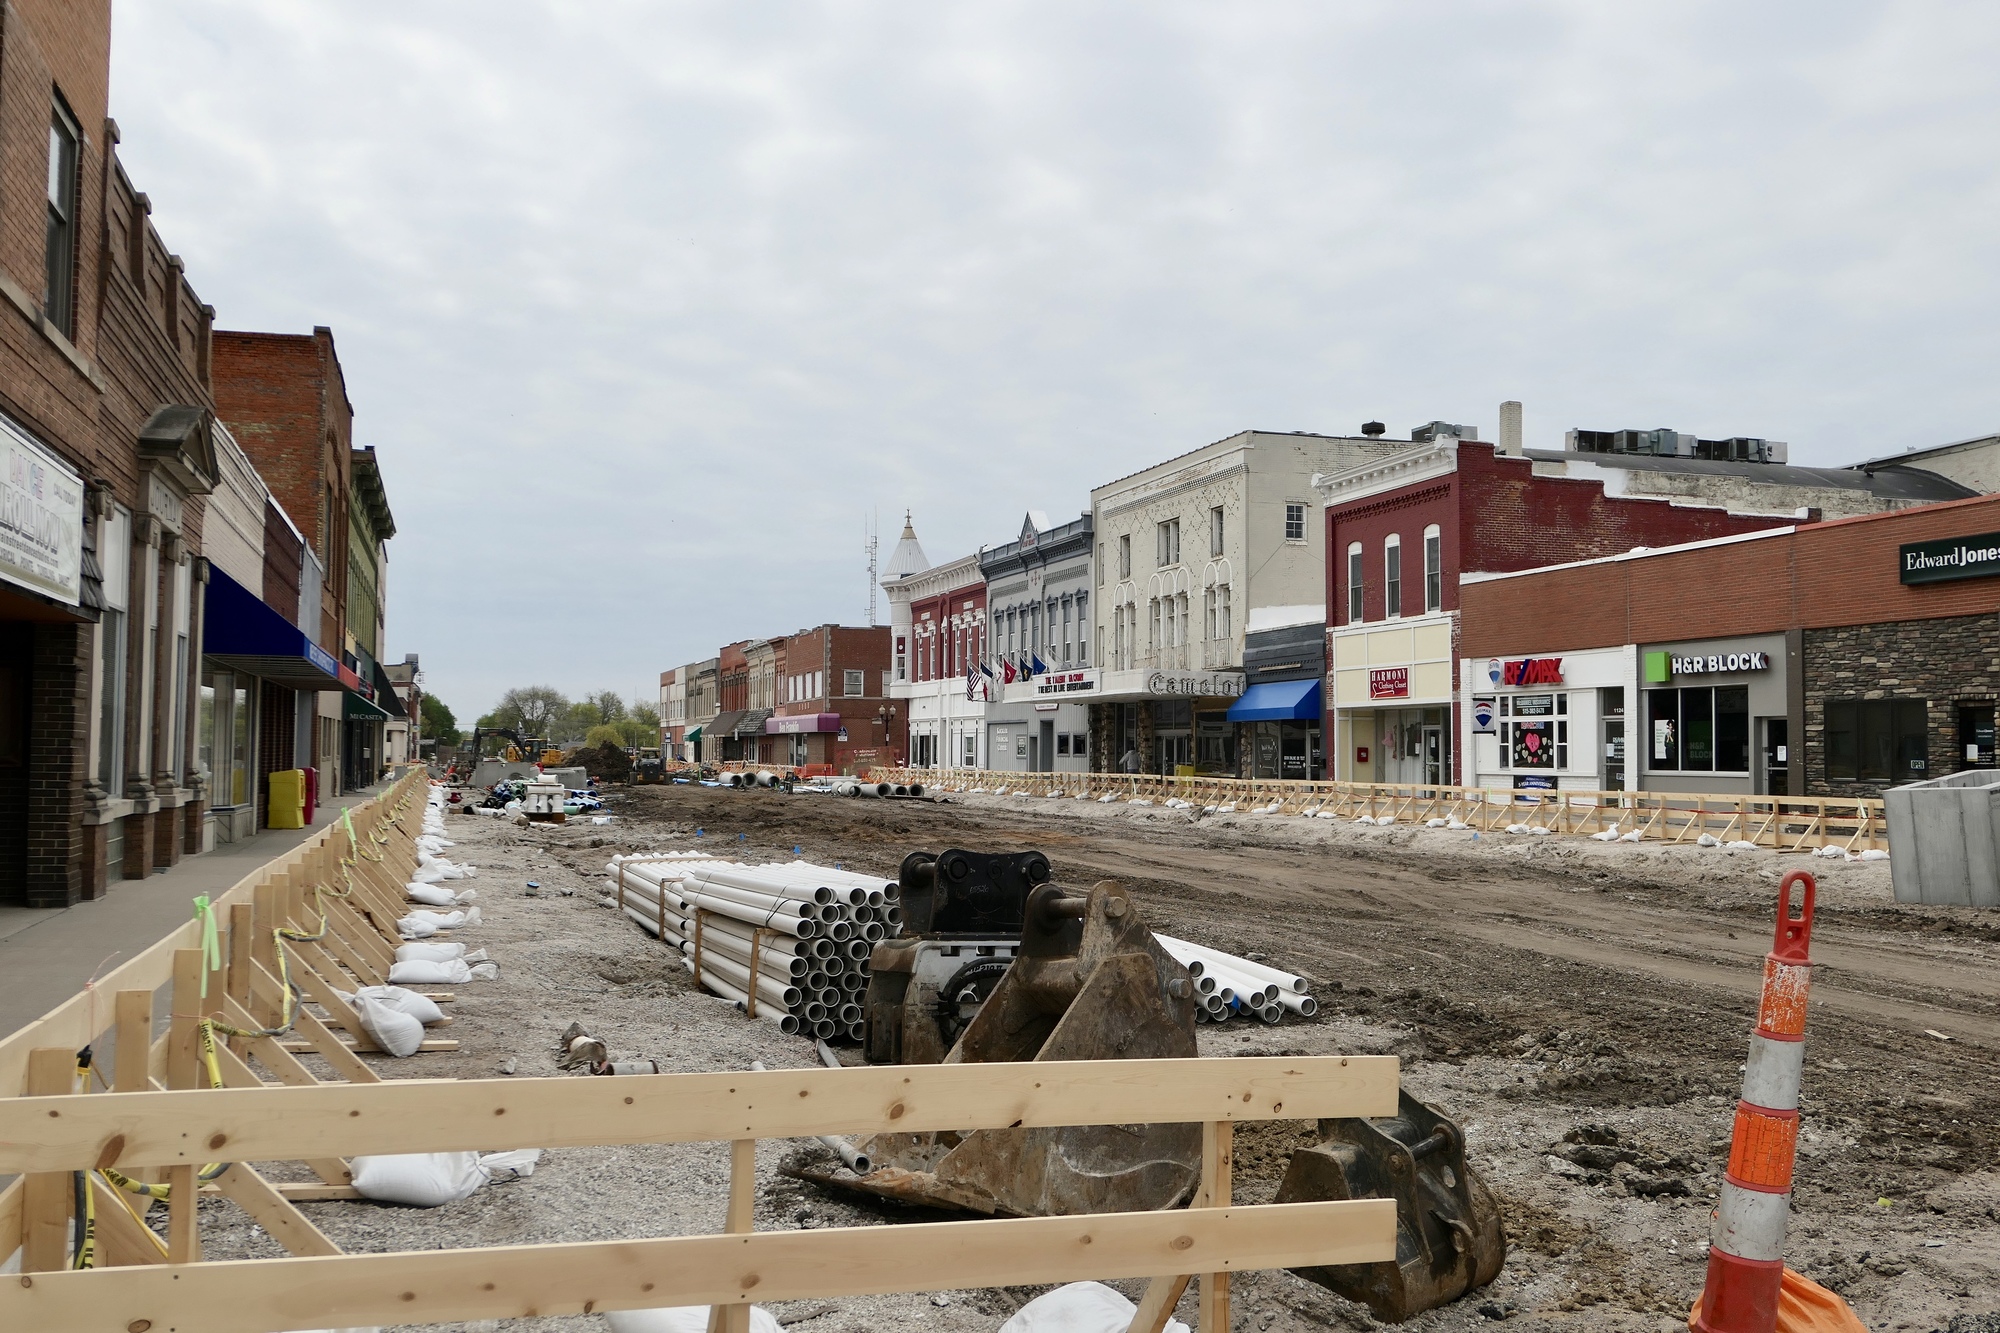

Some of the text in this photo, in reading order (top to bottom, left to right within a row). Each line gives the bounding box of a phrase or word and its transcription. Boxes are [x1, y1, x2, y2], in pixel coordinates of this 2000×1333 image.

[9, 448, 45, 501] DANCE
[63, 488, 77, 507] TODAY
[36, 503, 60, 554] NOW
[1905, 547, 1960, 571] Edward
[1504, 658, 1564, 686] RE/MAX
[1672, 652, 1765, 674] H&R BLOCK
[1148, 672, 1244, 697] Camelot
[1371, 669, 1407, 682] HARMONY
[1378, 681, 1394, 690] Clothing
[786, 721, 800, 733] Franklin
